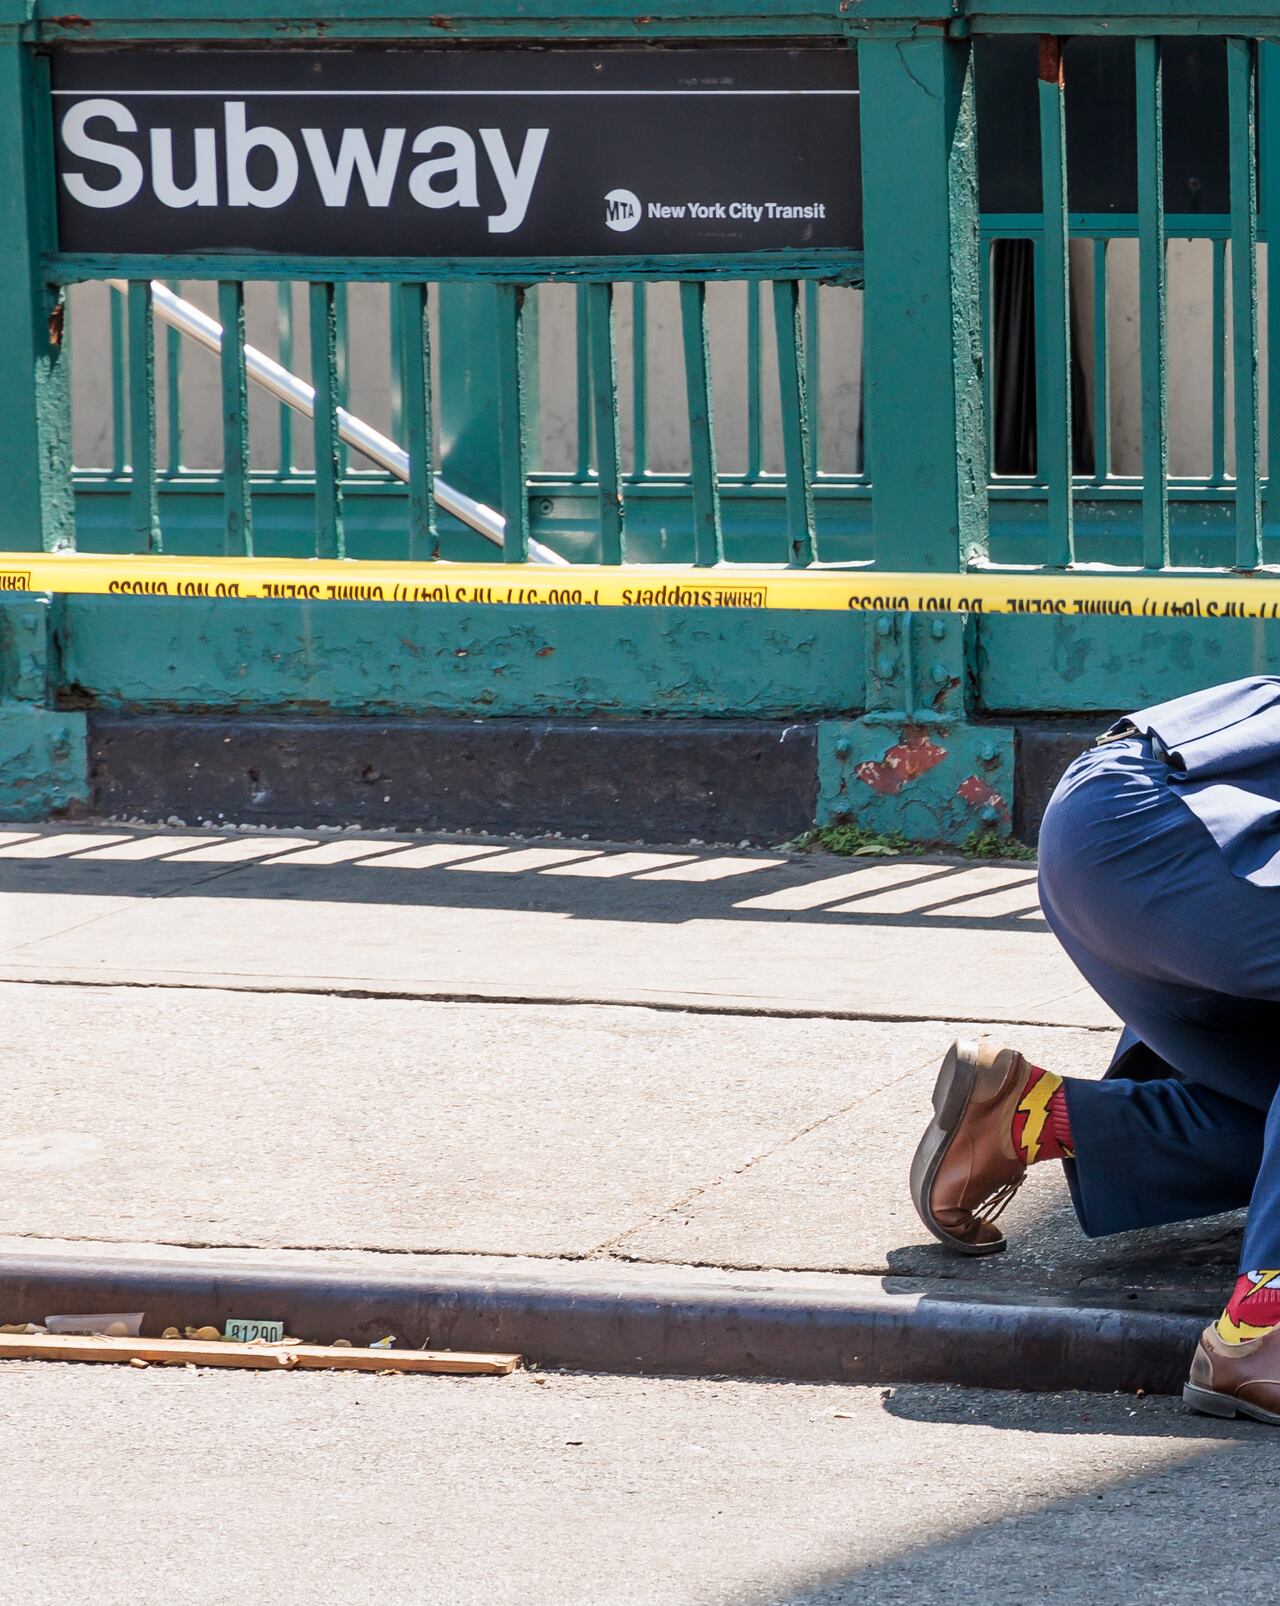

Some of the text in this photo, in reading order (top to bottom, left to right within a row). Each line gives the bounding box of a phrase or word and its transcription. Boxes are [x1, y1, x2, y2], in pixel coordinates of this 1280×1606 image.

[62, 99, 549, 233] Subway
[647, 202, 686, 219] New
[686, 202, 726, 219] York
[728, 202, 764, 222] City
[764, 202, 826, 219] Transit
[0, 575, 26, 592] CRI
